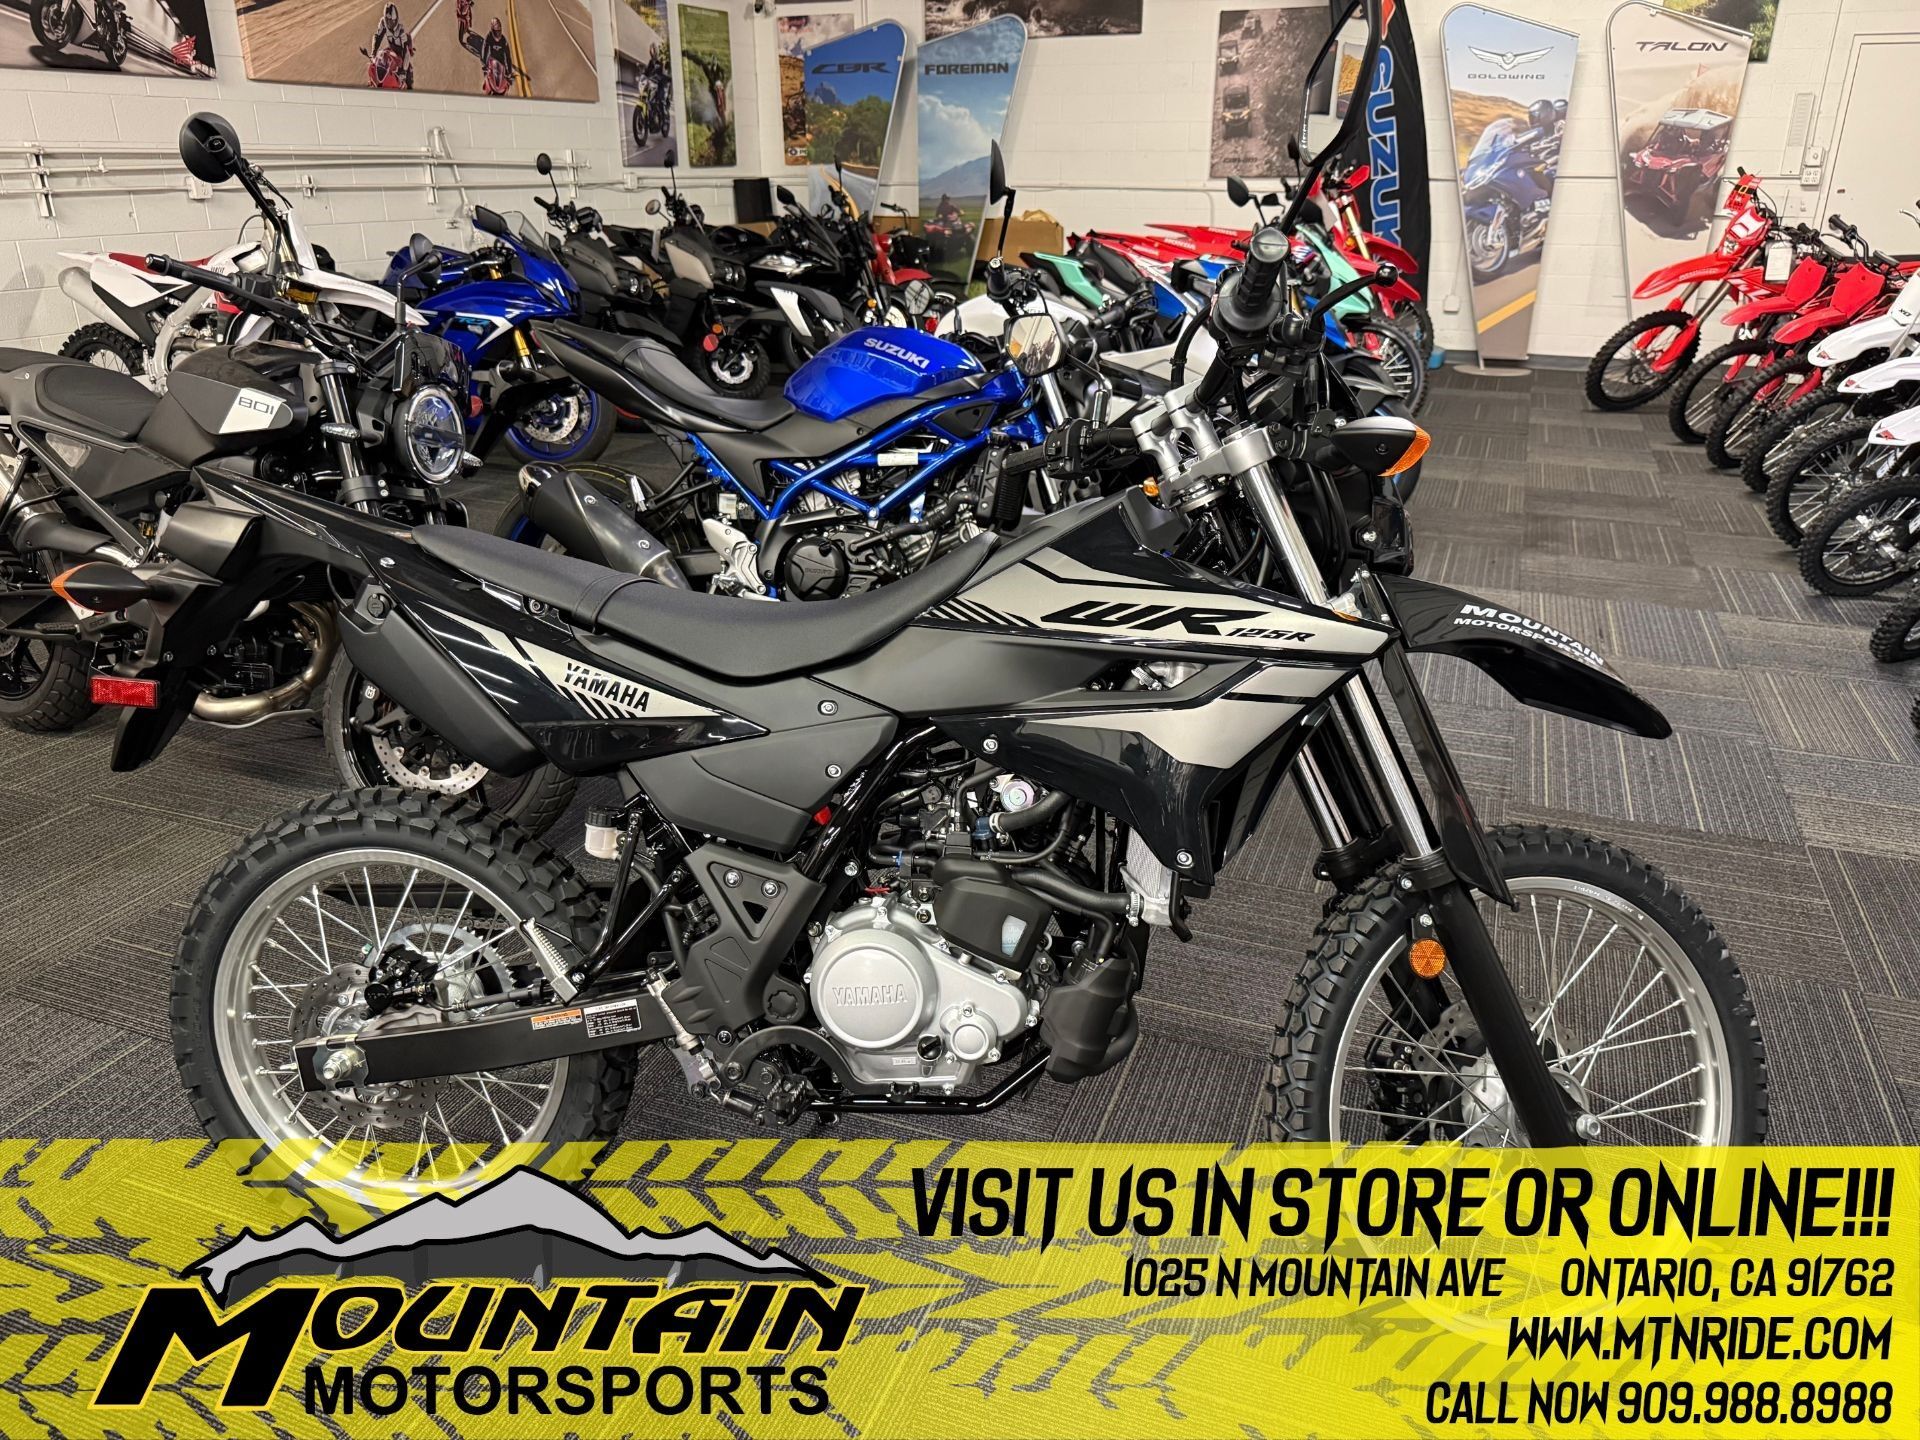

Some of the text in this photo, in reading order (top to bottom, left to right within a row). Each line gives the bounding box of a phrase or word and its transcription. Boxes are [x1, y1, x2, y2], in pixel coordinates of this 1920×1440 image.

[1636, 41, 1729, 52] TALON
[812, 62, 892, 74] CBR
[924, 62, 1009, 75] FOREMAN
[1366, 45, 1401, 248] SUZUK
[864, 338, 930, 369] SUZUKI
[239, 396, 275, 415] 801
[1040, 600, 1316, 643] WR 125R
[1460, 604, 1604, 666] MOUNTAIN
[564, 662, 650, 712] YAMAHA
[832, 983, 908, 1007] YAMAHA
